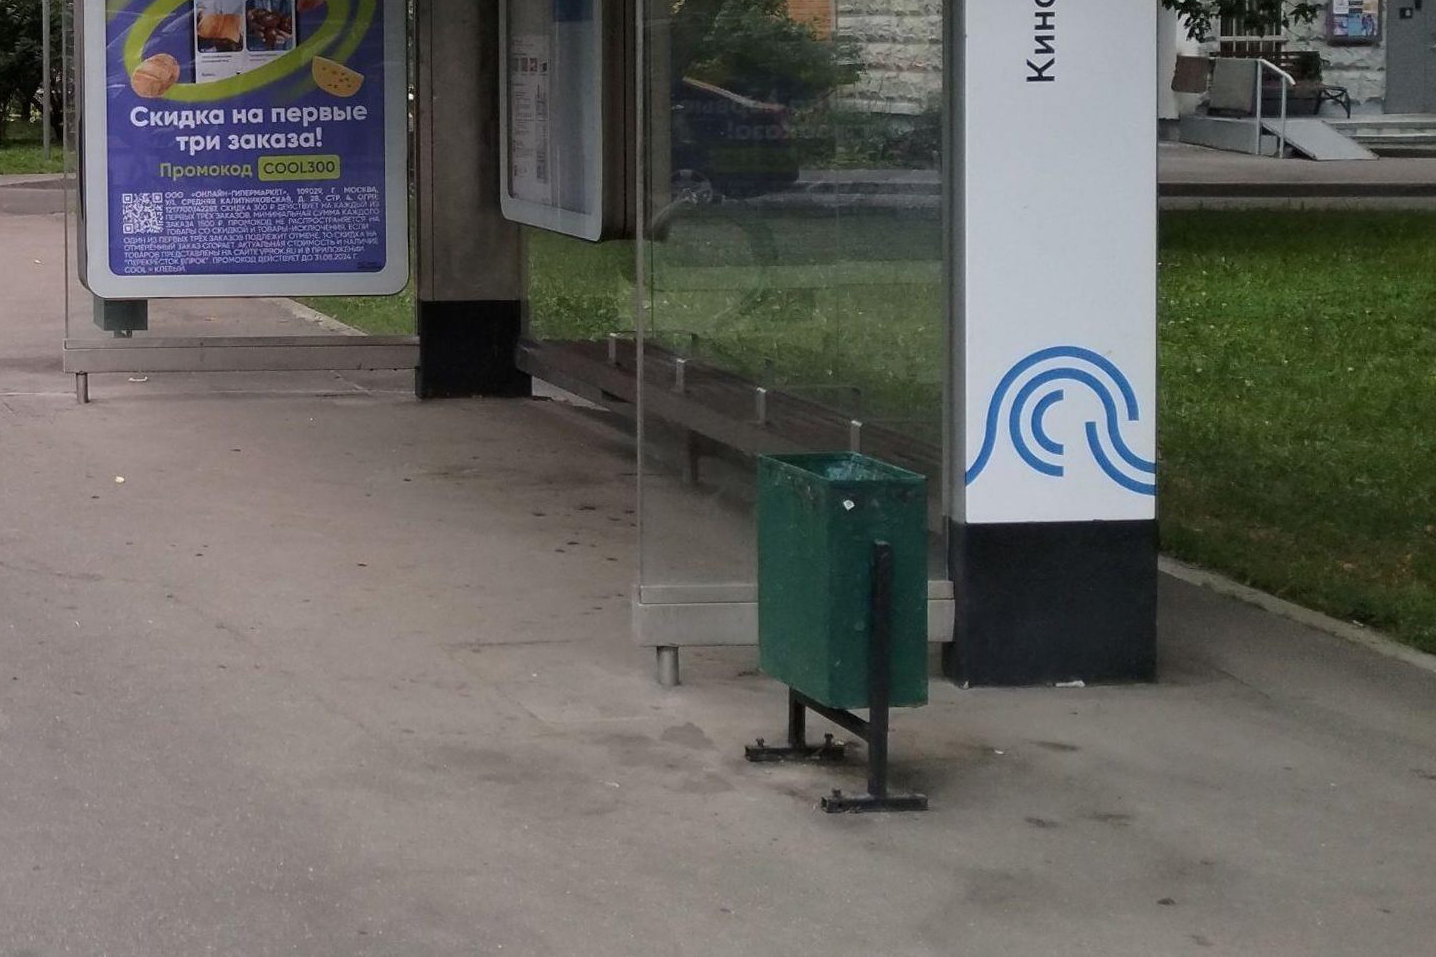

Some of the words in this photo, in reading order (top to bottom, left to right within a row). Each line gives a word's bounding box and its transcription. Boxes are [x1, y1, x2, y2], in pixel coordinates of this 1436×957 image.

[130, 106, 225, 129] Скидка
[233, 107, 263, 124] на
[271, 105, 368, 127] первые
[176, 133, 221, 156] три
[228, 127, 323, 150] заказа!
[159, 162, 253, 181] Промокод
[264, 161, 336, 174] COOL300
